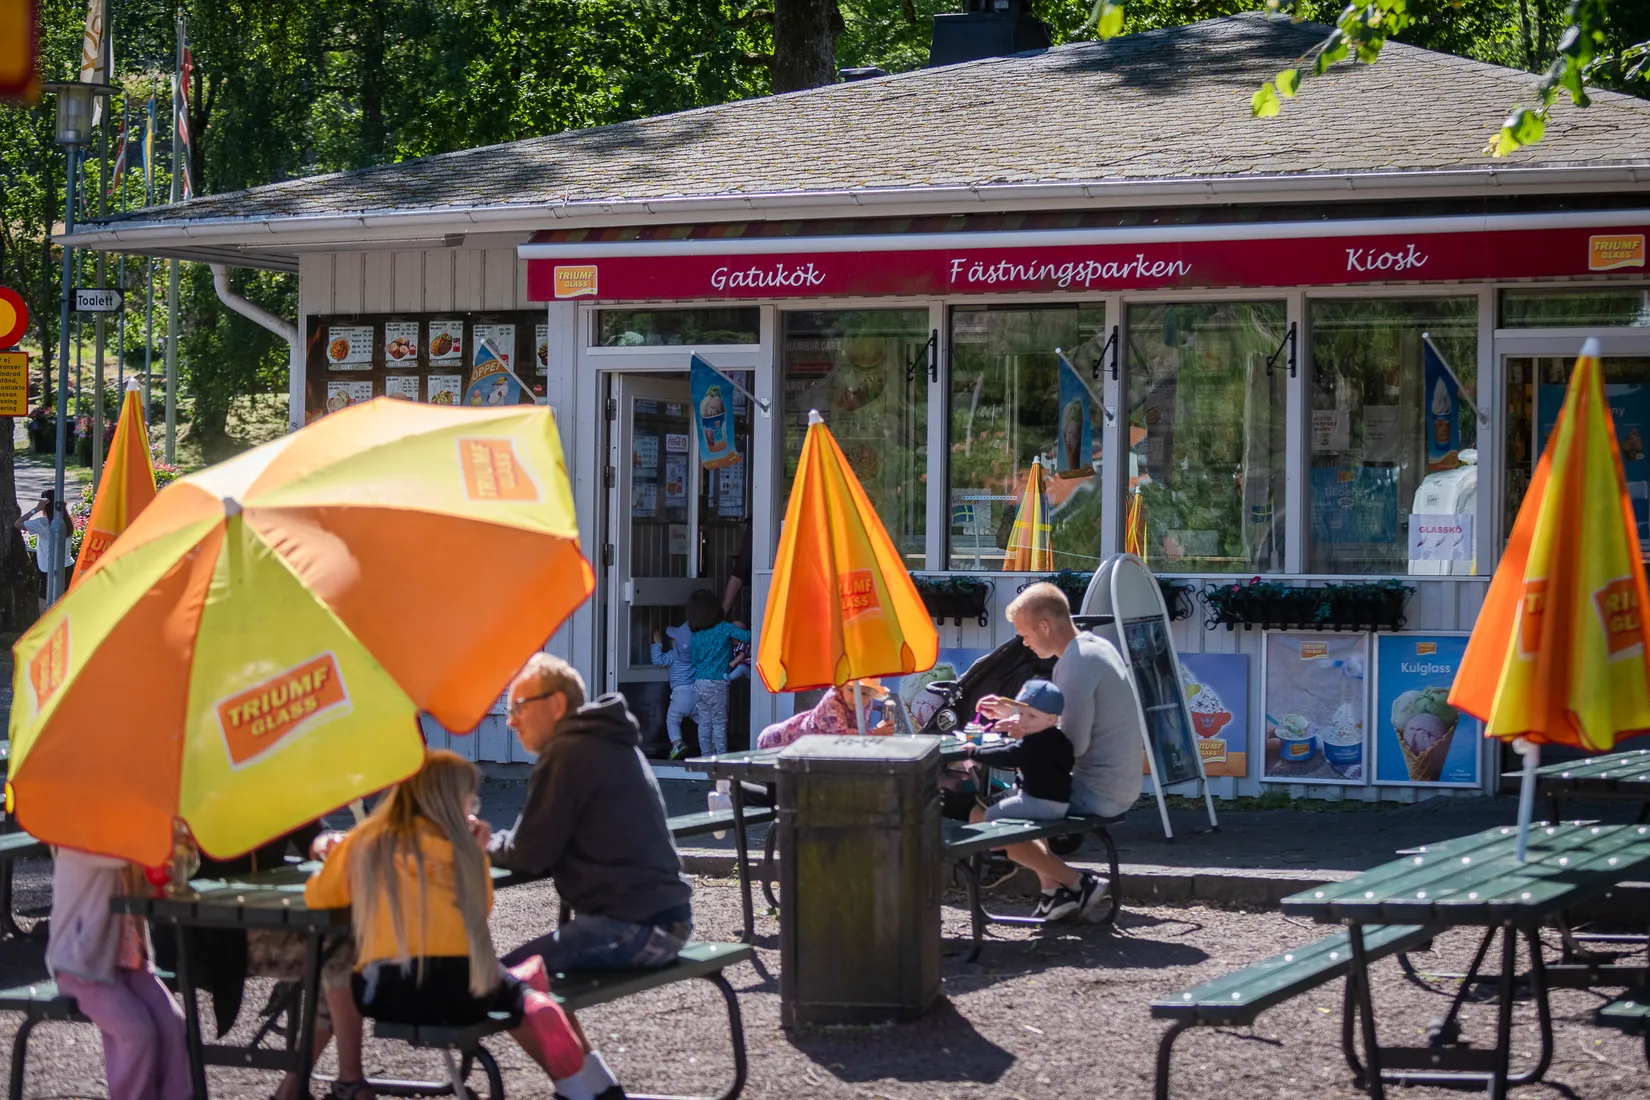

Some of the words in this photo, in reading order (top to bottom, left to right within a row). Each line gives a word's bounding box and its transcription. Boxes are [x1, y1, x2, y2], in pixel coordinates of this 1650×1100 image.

[1594, 240, 1640, 250] TRIUMF
[1345, 244, 1429, 272] Kiosk
[1601, 251, 1632, 259] GLASS
[558, 271, 594, 280] TRIUMF
[711, 263, 826, 290] Gatukök
[950, 253, 1192, 287] Fästningsparken
[564, 280, 588, 288] GLASS
[78, 295, 113, 306] Toalett
[840, 579, 872, 595] UMF
[842, 596, 869, 610] LASS
[1401, 662, 1451, 675] Kulglass
[228, 665, 329, 727] TRIUMF
[251, 694, 318, 736] GLASS
[1199, 742, 1223, 750] RIUMF
